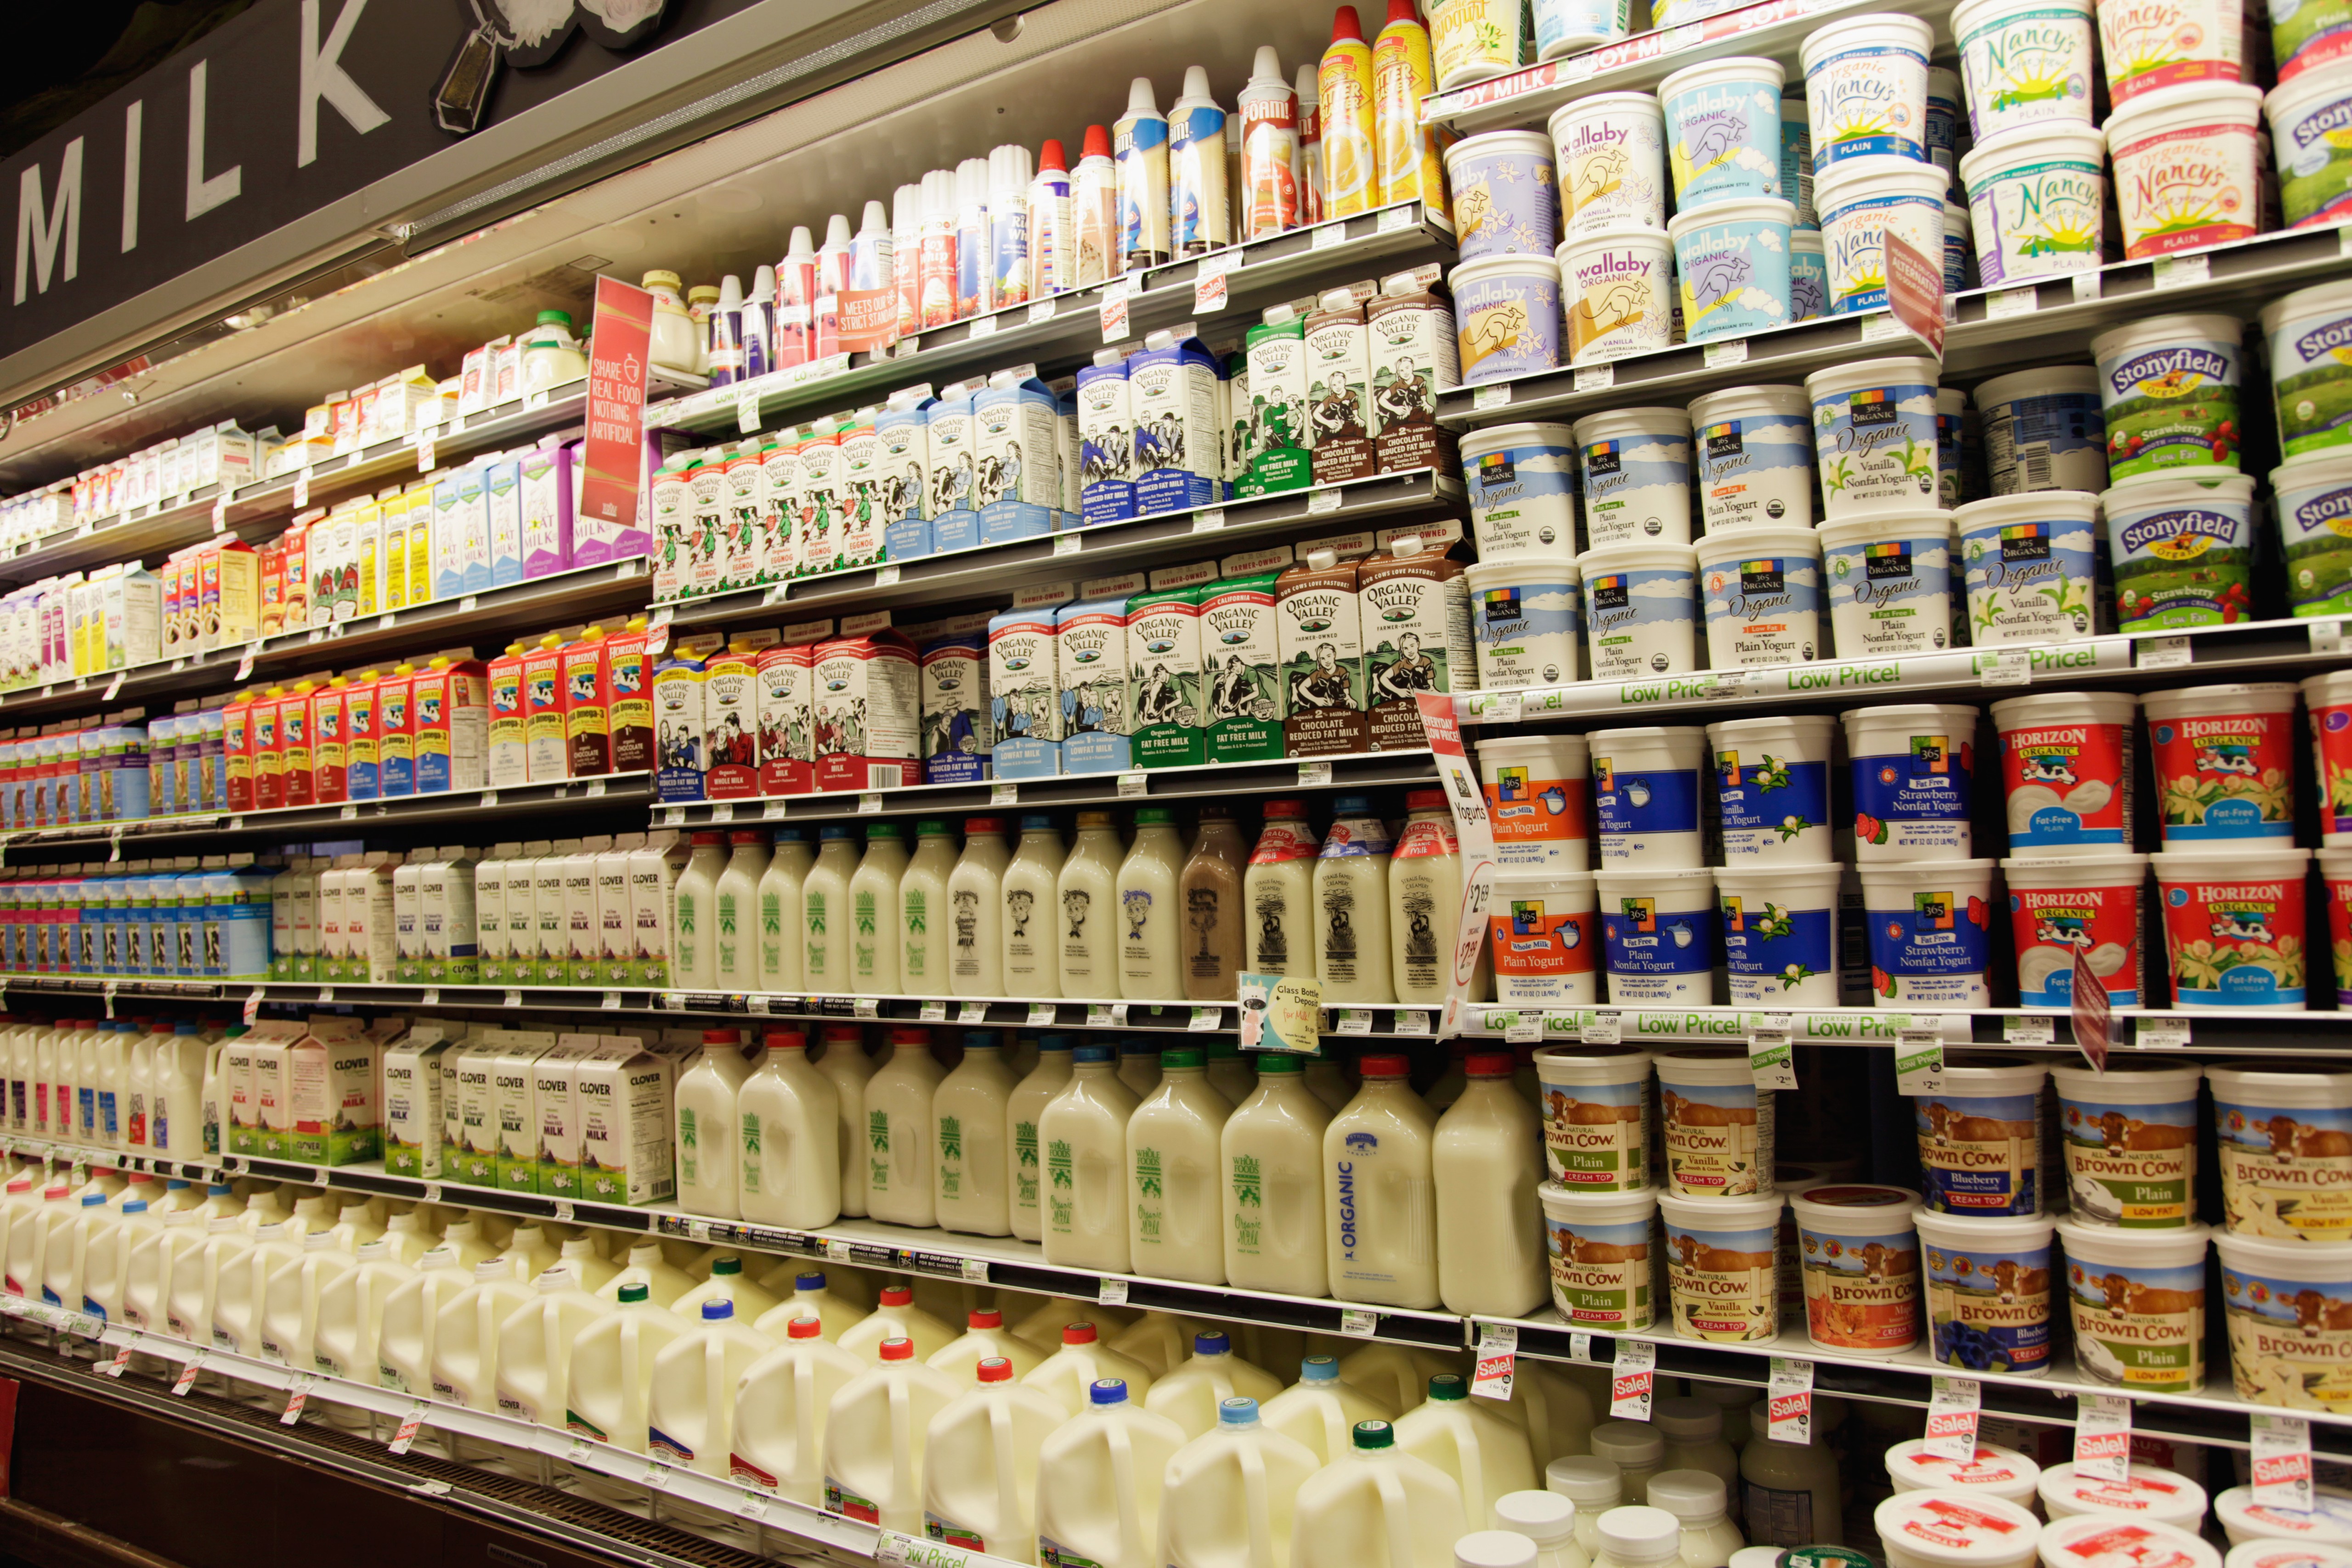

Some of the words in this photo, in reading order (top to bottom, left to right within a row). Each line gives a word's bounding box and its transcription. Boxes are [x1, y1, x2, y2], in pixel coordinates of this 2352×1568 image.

[1323, 56, 1342, 68] ORIGINAL
[1592, 41, 1632, 72] SOY
[1982, 24, 2075, 87] Nancy's
[1825, 60, 1886, 84] Organic
[1493, 69, 1546, 99] MILK
[1818, 75, 1895, 131] Nancy's
[2019, 107, 2056, 119] PLAIN
[14, 0, 390, 305] MILK
[1841, 141, 1871, 154] PLAIN
[2140, 143, 2212, 169] Organic
[2132, 161, 2224, 220] Nancy's
[923, 239, 944, 254] Soy
[2163, 234, 2199, 248] PLAIN
[1576, 251, 1651, 280] wallaby
[1581, 272, 1632, 288] ORGANIC
[1891, 259, 1940, 299] ALTERNATIVE
[1460, 279, 1526, 309] wallaby
[845, 300, 872, 316] MEETS
[873, 296, 886, 311] OUR
[1464, 300, 1506, 317] ORGANIC
[840, 315, 866, 331] STRICT
[868, 305, 899, 327] STANDARDS
[594, 359, 622, 381] SHARE
[1474, 363, 1497, 372] VANILLA
[1499, 360, 1519, 368] BEAN
[2114, 349, 2224, 389] Stonyfield
[1136, 369, 1173, 387] ORGANIC
[1141, 378, 1170, 390] VALLEY
[592, 378, 614, 397] REAL
[2147, 379, 2195, 398] Organic
[594, 400, 629, 423] NOTHING
[1866, 404, 1881, 413] 365
[1853, 410, 1894, 423] ORGANIC
[1837, 420, 1910, 457] Organic
[2141, 423, 2204, 441] Strawberry
[1387, 433, 1425, 446] CHOCOLATE
[2152, 451, 2174, 463] Low
[2179, 450, 2198, 460] Fat
[1490, 466, 1502, 474] 365
[1860, 460, 1896, 473] Vanilla
[1481, 471, 1513, 484] ORGANIC
[1846, 476, 1879, 490] Nonfat
[1880, 473, 1913, 487] Yogurt
[1137, 484, 1161, 496] REDUCED
[1171, 479, 1184, 490] MILK
[1473, 480, 1526, 512] Organic
[1500, 510, 1513, 519] Free
[1707, 503, 1725, 518] Plain
[1725, 500, 1758, 515] Yogurt
[1493, 521, 1512, 532] Plain
[2124, 511, 2235, 550] Stonyfield
[524, 531, 552, 548] MILK
[1481, 531, 1503, 544] Nonfat
[1504, 529, 1531, 543] Yogurt
[849, 540, 874, 550] EGGNOG
[1280, 588, 1291, 597] OUR
[1292, 582, 1307, 592] COWS
[1323, 580, 1349, 589] PASTURE!
[1144, 605, 1175, 615] CALIFORNIA
[1286, 595, 1340, 614] ORGANIC
[1293, 607, 1337, 622] VALLEY
[1882, 620, 1905, 631] Plain
[1295, 632, 1337, 642] FARMER-OWNED
[1863, 631, 1894, 644] Nonfat
[1895, 629, 1925, 643] Yogurt
[2168, 637, 2185, 646] 4.49
[609, 642, 644, 660] HORIZON
[611, 657, 640, 667] ORGANIC
[819, 660, 855, 674] ORGANIC
[1787, 671, 1838, 690] Low
[1839, 662, 1900, 685] Price!
[415, 678, 444, 691] HORIZON
[621, 698, 650, 712] Omega-3
[1300, 719, 1344, 731] CHOCOLATE
[2182, 718, 2268, 738] HORIZON
[1290, 731, 1322, 741] REDUCED
[1323, 729, 1337, 739] FAT
[1340, 727, 1359, 737] MILK
[2011, 728, 2086, 750] HORIZON
[617, 743, 643, 752] CHOCOLATE
[1141, 739, 1153, 749] FAT
[1153, 738, 1170, 748] FREE
[1171, 736, 1189, 746] MILK
[2196, 736, 2257, 746] ORGANIC
[1921, 749, 1939, 759] 365
[2022, 747, 2077, 757] ORGANIC
[1916, 779, 1928, 788] Fat
[1930, 778, 1944, 787] Free
[1899, 789, 1958, 802] Strawberry
[1893, 801, 1930, 811] Nonfat
[1931, 801, 1962, 813] Yogurt
[1454, 802, 1487, 826] Yogurts
[2035, 814, 2073, 825] Fat-Free
[2219, 818, 2250, 826] VANILLA
[1414, 844, 1428, 855] Milk
[632, 874, 658, 884] CLOVER
[1629, 909, 1645, 920] 365
[1511, 942, 1530, 951] Whole
[1532, 940, 1550, 949] Milk
[1639, 937, 1652, 946] Free
[1628, 950, 1653, 960] Plain
[1504, 955, 1526, 967] Plain
[1528, 955, 1564, 970] Yogurt
[1278, 985, 1299, 996] Glass
[1301, 987, 1319, 999] Bottle
[1294, 996, 1318, 1008] Deposit
[1638, 1013, 1679, 1034] Low
[1686, 1013, 1741, 1036] Price!
[2030, 1017, 2050, 1026] $4.39
[256, 1059, 277, 1070] CLOVER
[334, 1058, 369, 1071] CLOVER
[1750, 1056, 1768, 1070] Low
[1769, 1047, 1790, 1063] Price!
[387, 1068, 411, 1080] CLOVER
[630, 1073, 660, 1086] CLOVER
[586, 1129, 607, 1141] MILK
[1688, 1155, 1719, 1166] Vanilla
[2075, 1156, 2137, 1175] Brown
[2142, 1161, 2183, 1177] Cow
[1234, 1164, 1260, 1174] FOODS
[1951, 1173, 2000, 1186] Blueberry
[2135, 1187, 2172, 1200] Plain
[1339, 1161, 1354, 1248] ORGANIC
[2134, 1207, 2152, 1216] LOW
[2155, 1207, 2174, 1215] FAT
[1582, 1294, 1611, 1307] Plain
[316, 1355, 332, 1366] CLOVER
[1615, 1376, 1649, 1395] Sale!
[499, 1399, 520, 1410] CLOVER
[398, 1424, 417, 1438] Sale!
[1930, 1415, 1973, 1434] Sale!
